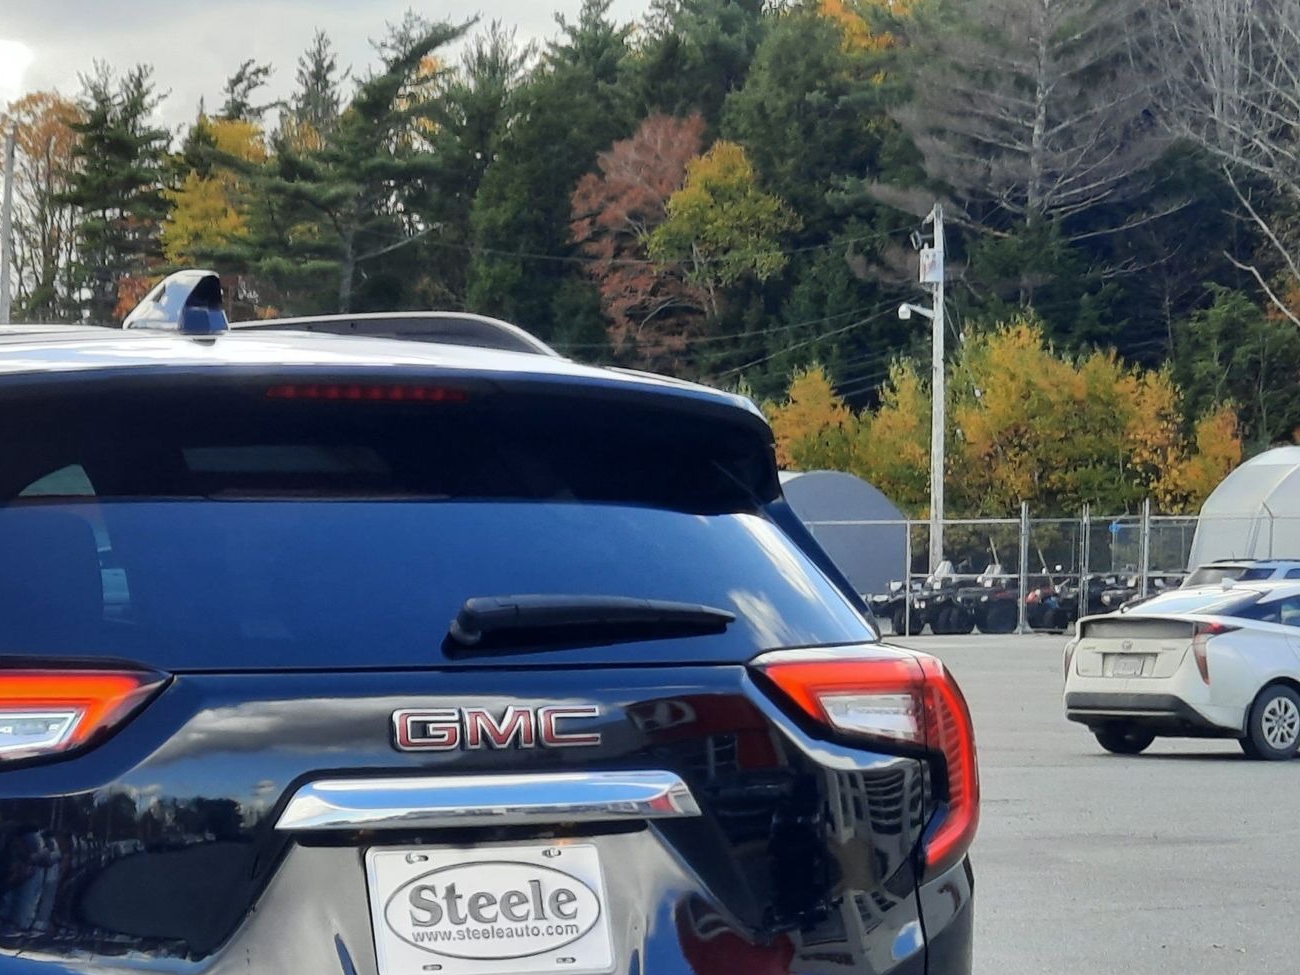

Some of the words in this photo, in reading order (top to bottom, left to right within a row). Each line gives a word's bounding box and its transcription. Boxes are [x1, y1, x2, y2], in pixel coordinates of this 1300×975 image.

[392, 704, 601, 752] GMC
[408, 879, 578, 928] Steele
[412, 921, 579, 943] www.steeleauto.com
